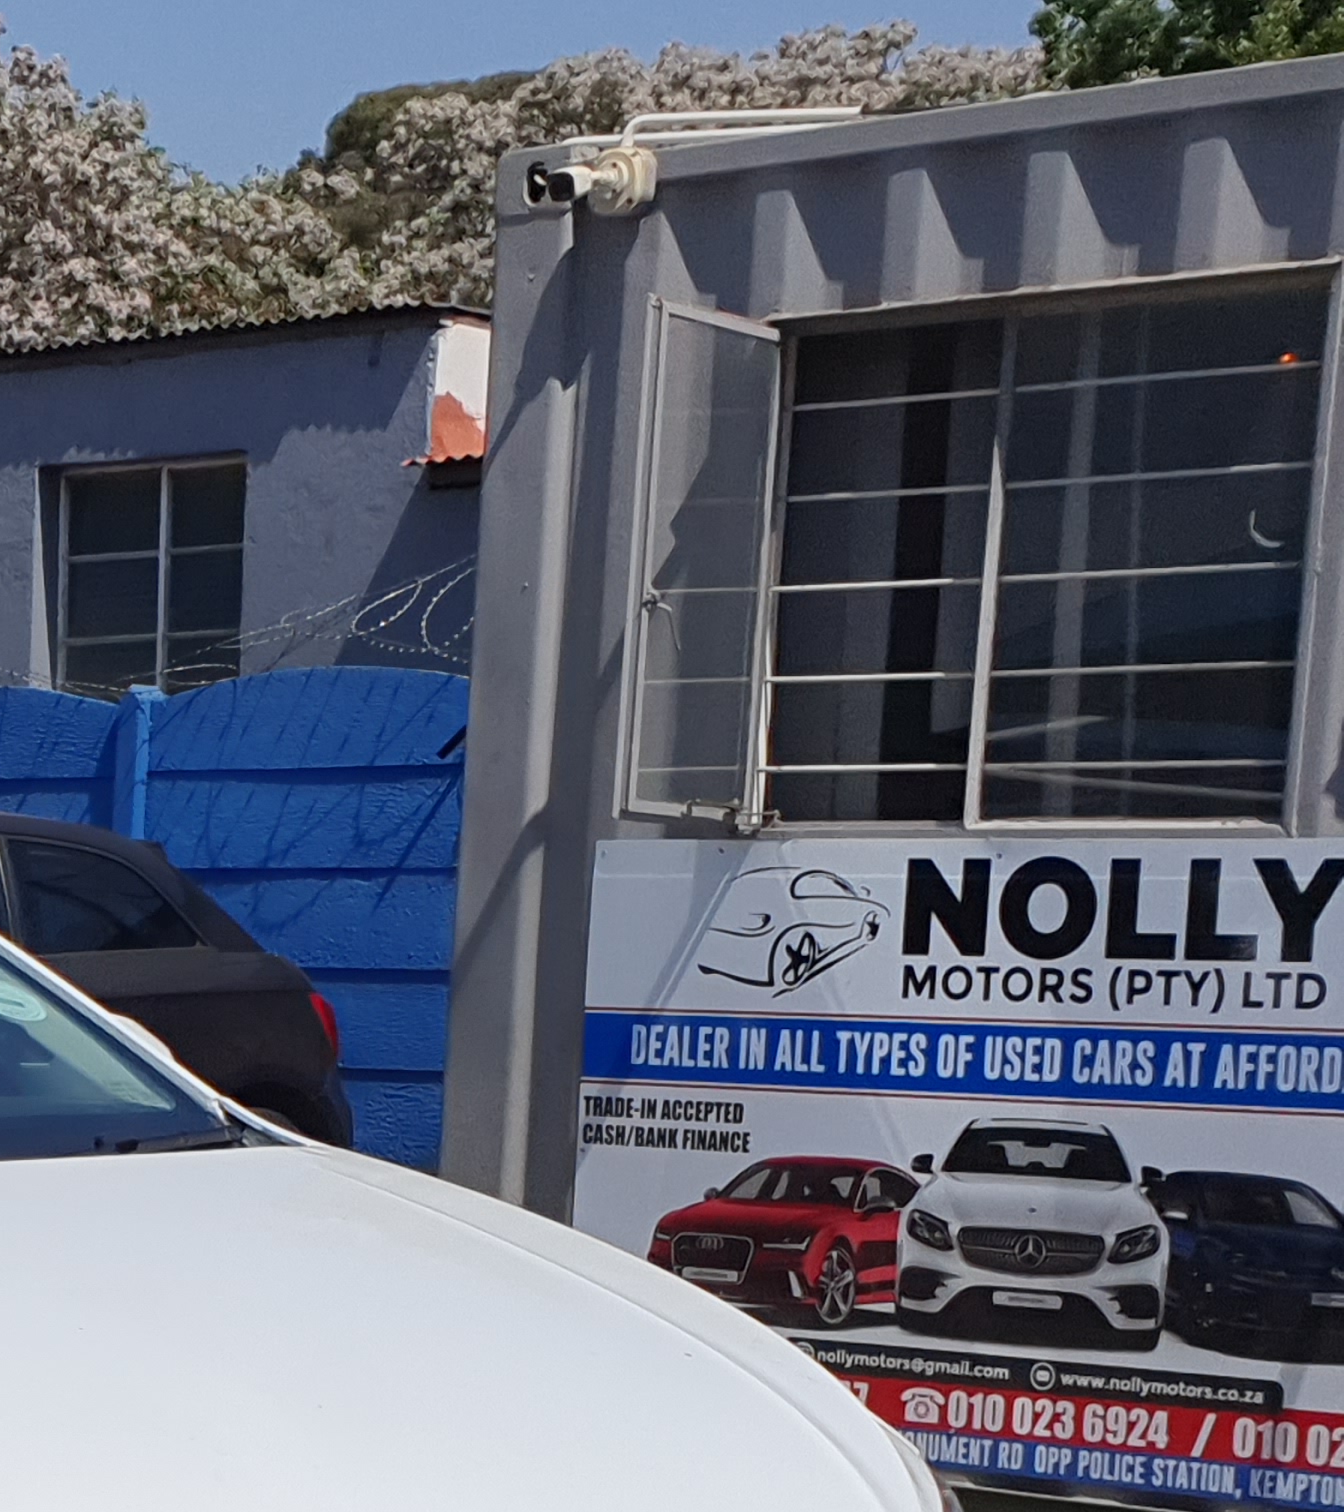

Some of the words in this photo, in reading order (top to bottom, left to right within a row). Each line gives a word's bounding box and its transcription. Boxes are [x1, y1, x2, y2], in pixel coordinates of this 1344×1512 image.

[901, 856, 1344, 962] NOLLY
[901, 965, 1093, 1003] MOTORS
[1109, 966, 1225, 1013] (PTY)
[1242, 972, 1327, 1010] LTD
[630, 1024, 730, 1069] DEALER
[739, 1027, 766, 1070] IN
[774, 1029, 825, 1073] ALL
[836, 1031, 927, 1077] TYPES
[936, 1034, 975, 1079] OF
[983, 1035, 1062, 1082] USED
[1072, 1039, 1156, 1085] CARS
[1163, 1042, 1206, 1088] AT
[1213, 1044, 1344, 1093] AFFORD
[583, 1096, 657, 1120] TRADE-IN
[661, 1099, 744, 1124] ACCEPTED
[582, 1124, 678, 1149] CASH/BANK
[682, 1130, 751, 1153] FINANCE
[816, 1349, 1010, 1380] nollymotors@gmail.com
[1060, 1372, 1264, 1404] www.nollymotors.co.za
[947, 1390, 1005, 1432] 010
[1012, 1396, 1076, 1440] 023
[1082, 1402, 1169, 1449] 6924
[1233, 1417, 1299, 1463] 010
[997, 1442, 1023, 1470] RD
[1034, 1445, 1072, 1475] OPP
[1077, 1449, 1145, 1484] POLICE
[1151, 1458, 1243, 1499] STATION,
